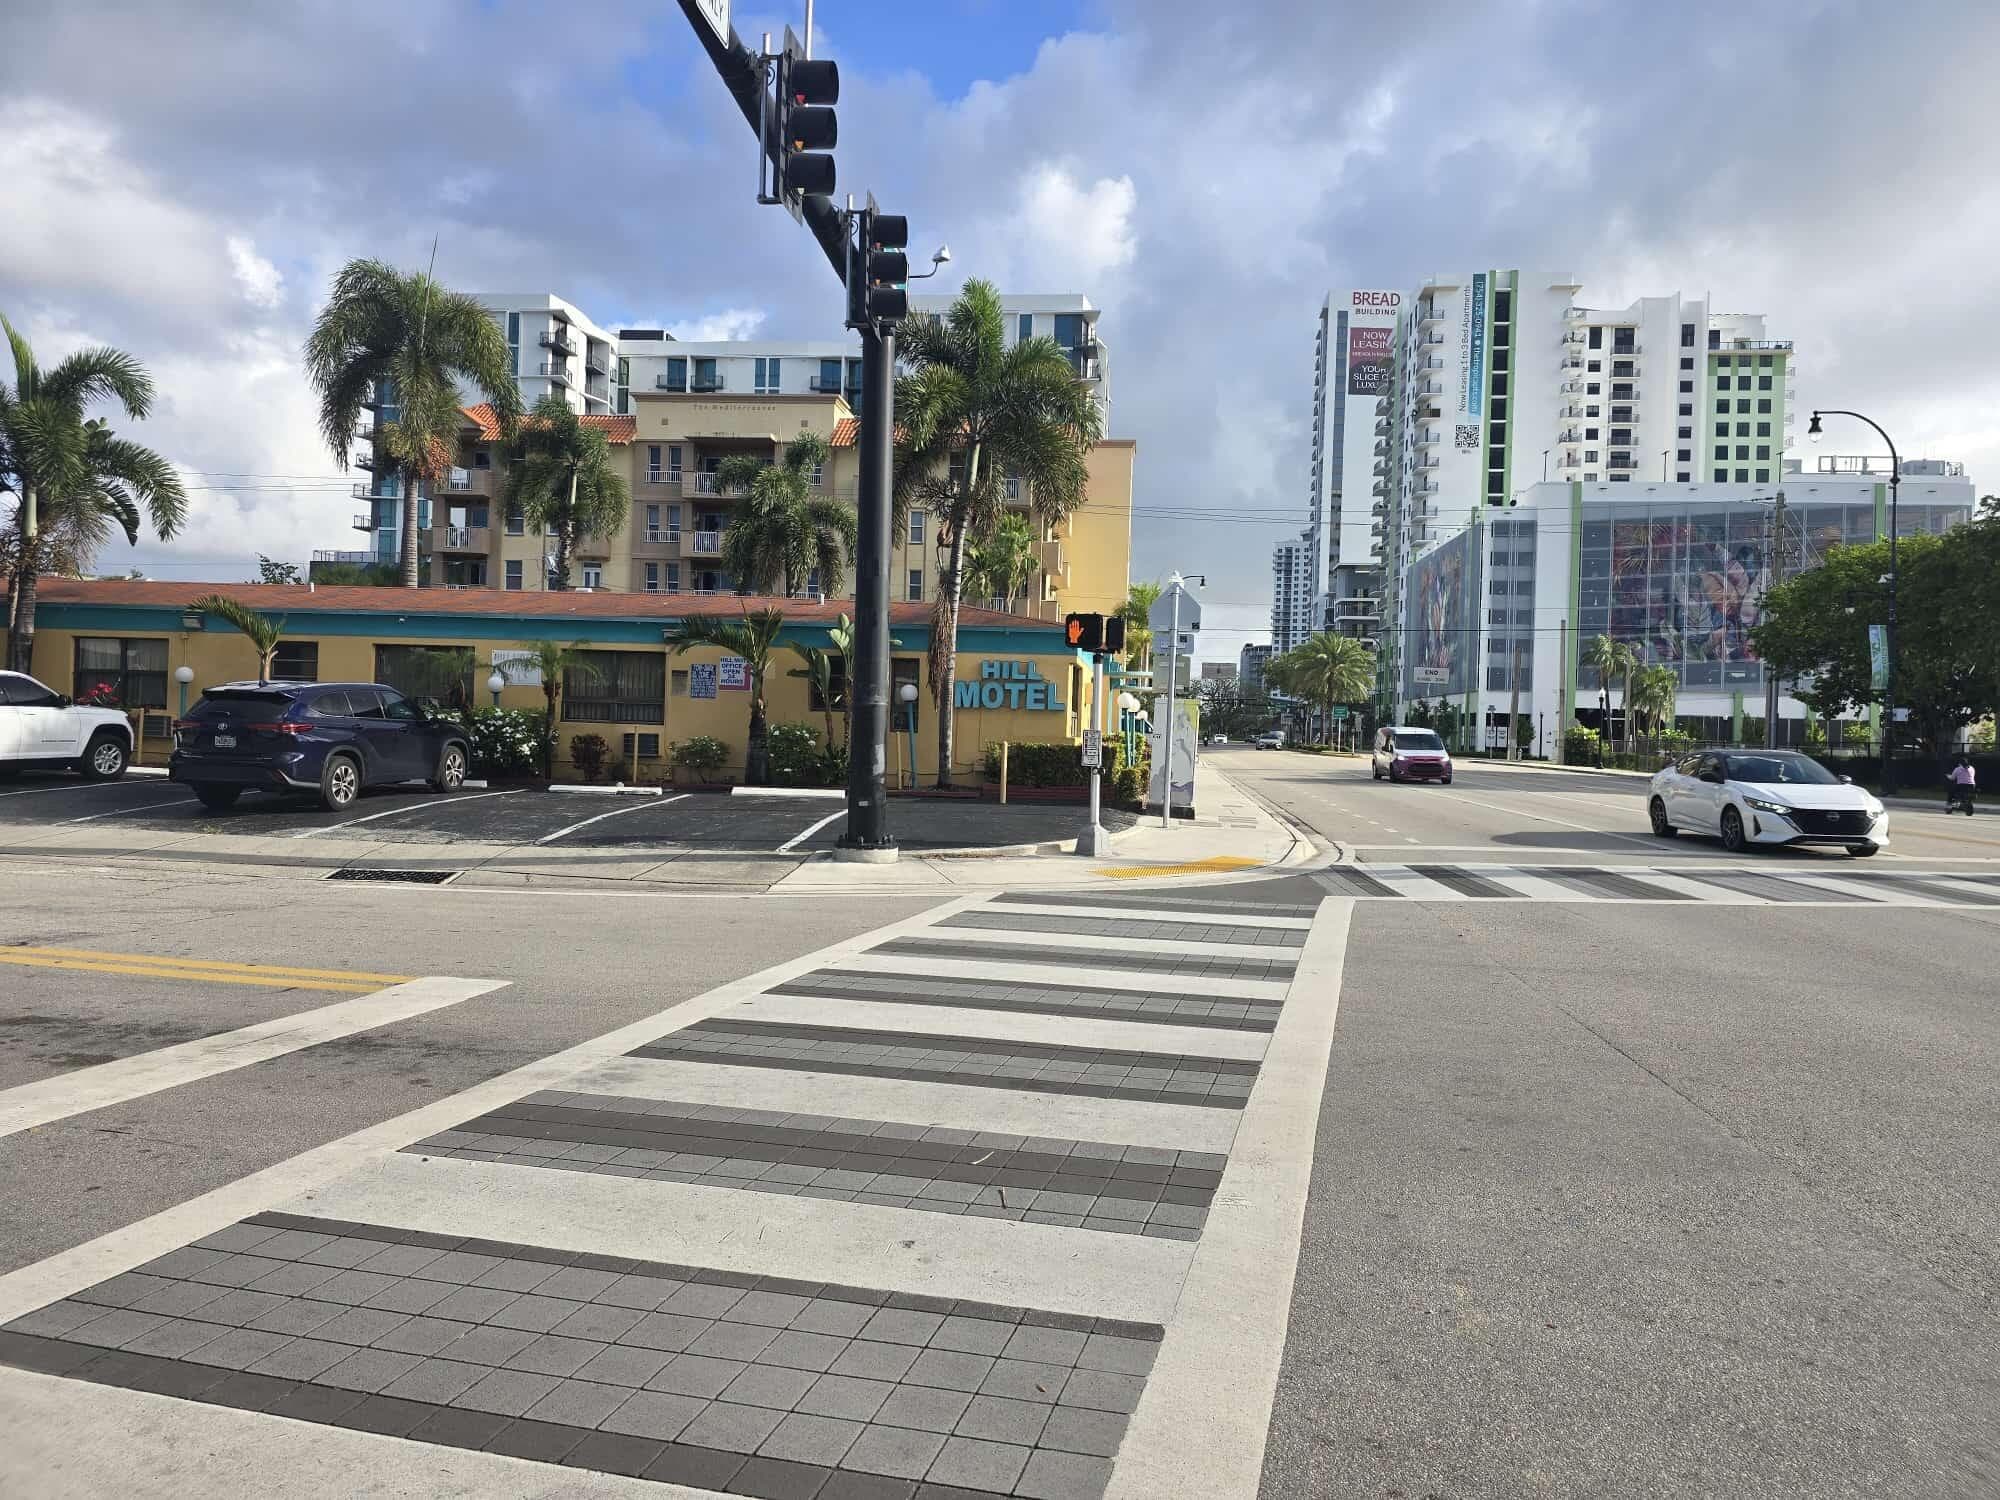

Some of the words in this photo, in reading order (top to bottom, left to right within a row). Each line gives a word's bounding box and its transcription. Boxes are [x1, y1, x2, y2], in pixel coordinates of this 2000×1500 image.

[1353, 291, 1400, 306] BREAD
[1463, 285, 1471, 328] Apartments
[1355, 308, 1396, 316] BUILDING
[1363, 331, 1387, 340] NOW
[1353, 373, 1380, 381] SLICE
[1460, 367, 1468, 392] Leasing
[1459, 393, 1467, 411] Now
[982, 659, 1042, 680] HILL
[955, 681, 1065, 710] MOTEL
